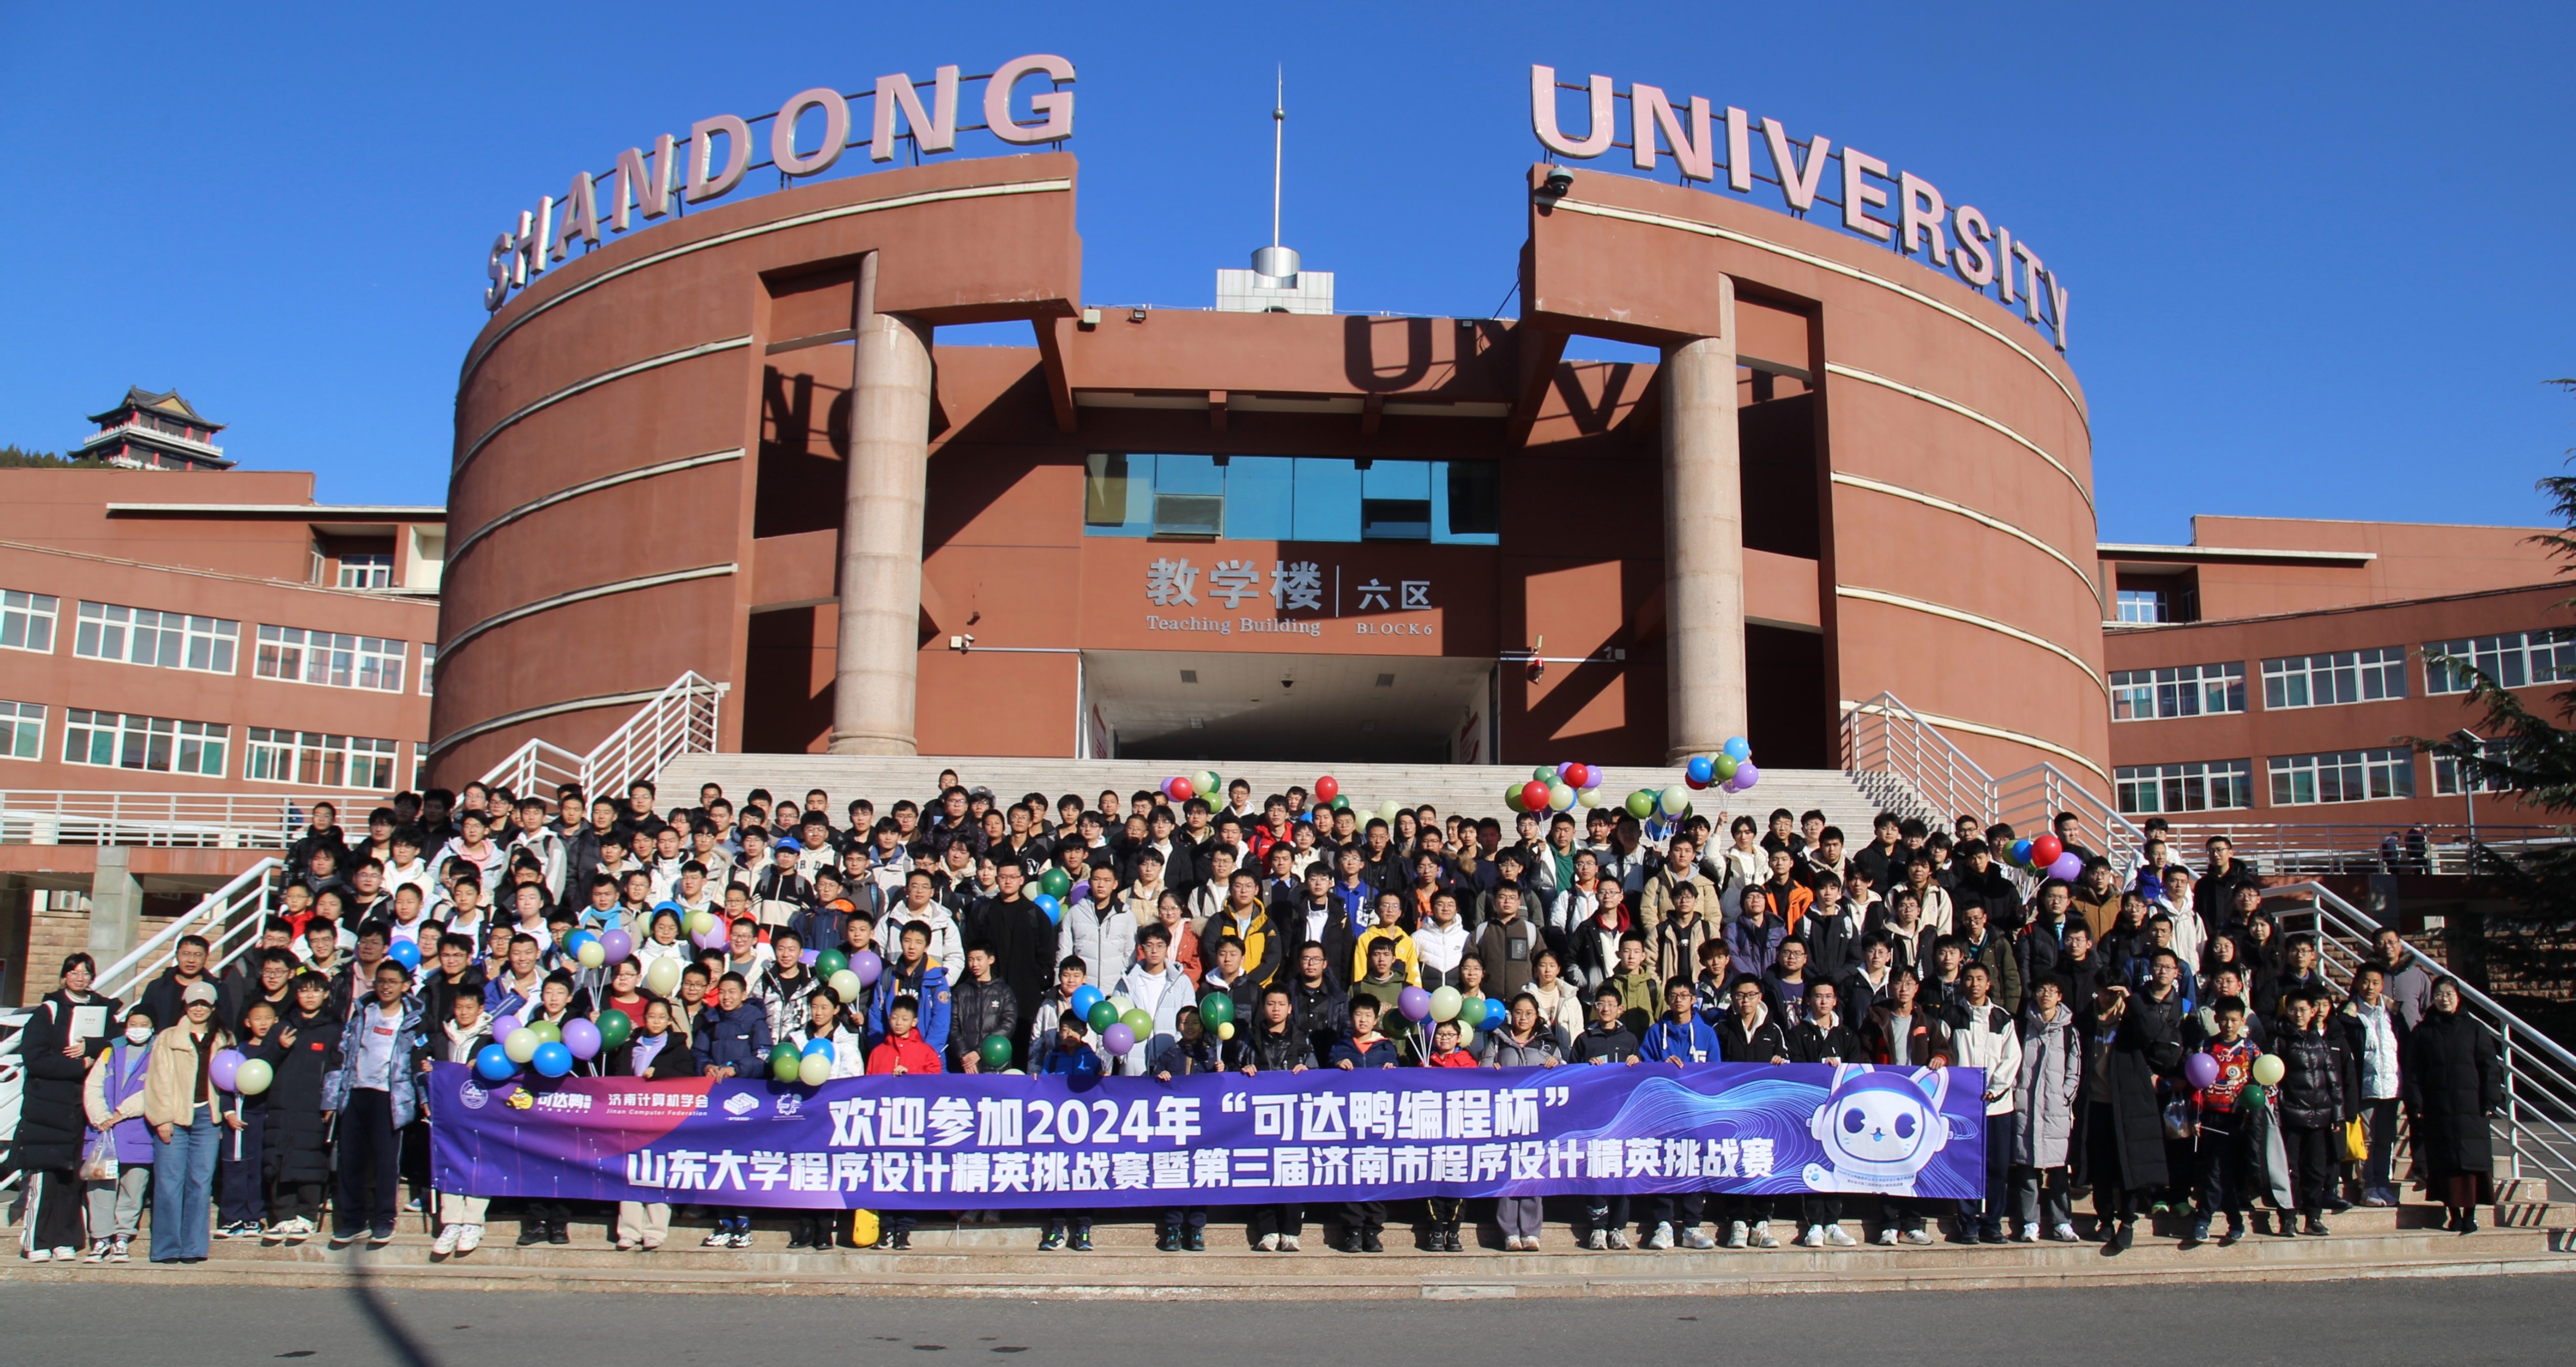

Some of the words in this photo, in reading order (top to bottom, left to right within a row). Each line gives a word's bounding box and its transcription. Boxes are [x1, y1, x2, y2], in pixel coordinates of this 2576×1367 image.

[484, 54, 1076, 312] SHANDONG
[1531, 64, 2068, 351] UNIVERSITY
[1146, 557, 1322, 610] 教学楼
[1357, 578, 1432, 610] 六区
[1147, 616, 1231, 634] Teaching
[1239, 618, 1321, 636] Building
[608, 1093, 709, 1108] 济南计算机学会
[628, 1137, 1774, 1192] 山东大学程序设计精英挑战赛暨第三届济南市程序设计精英挑战赛
